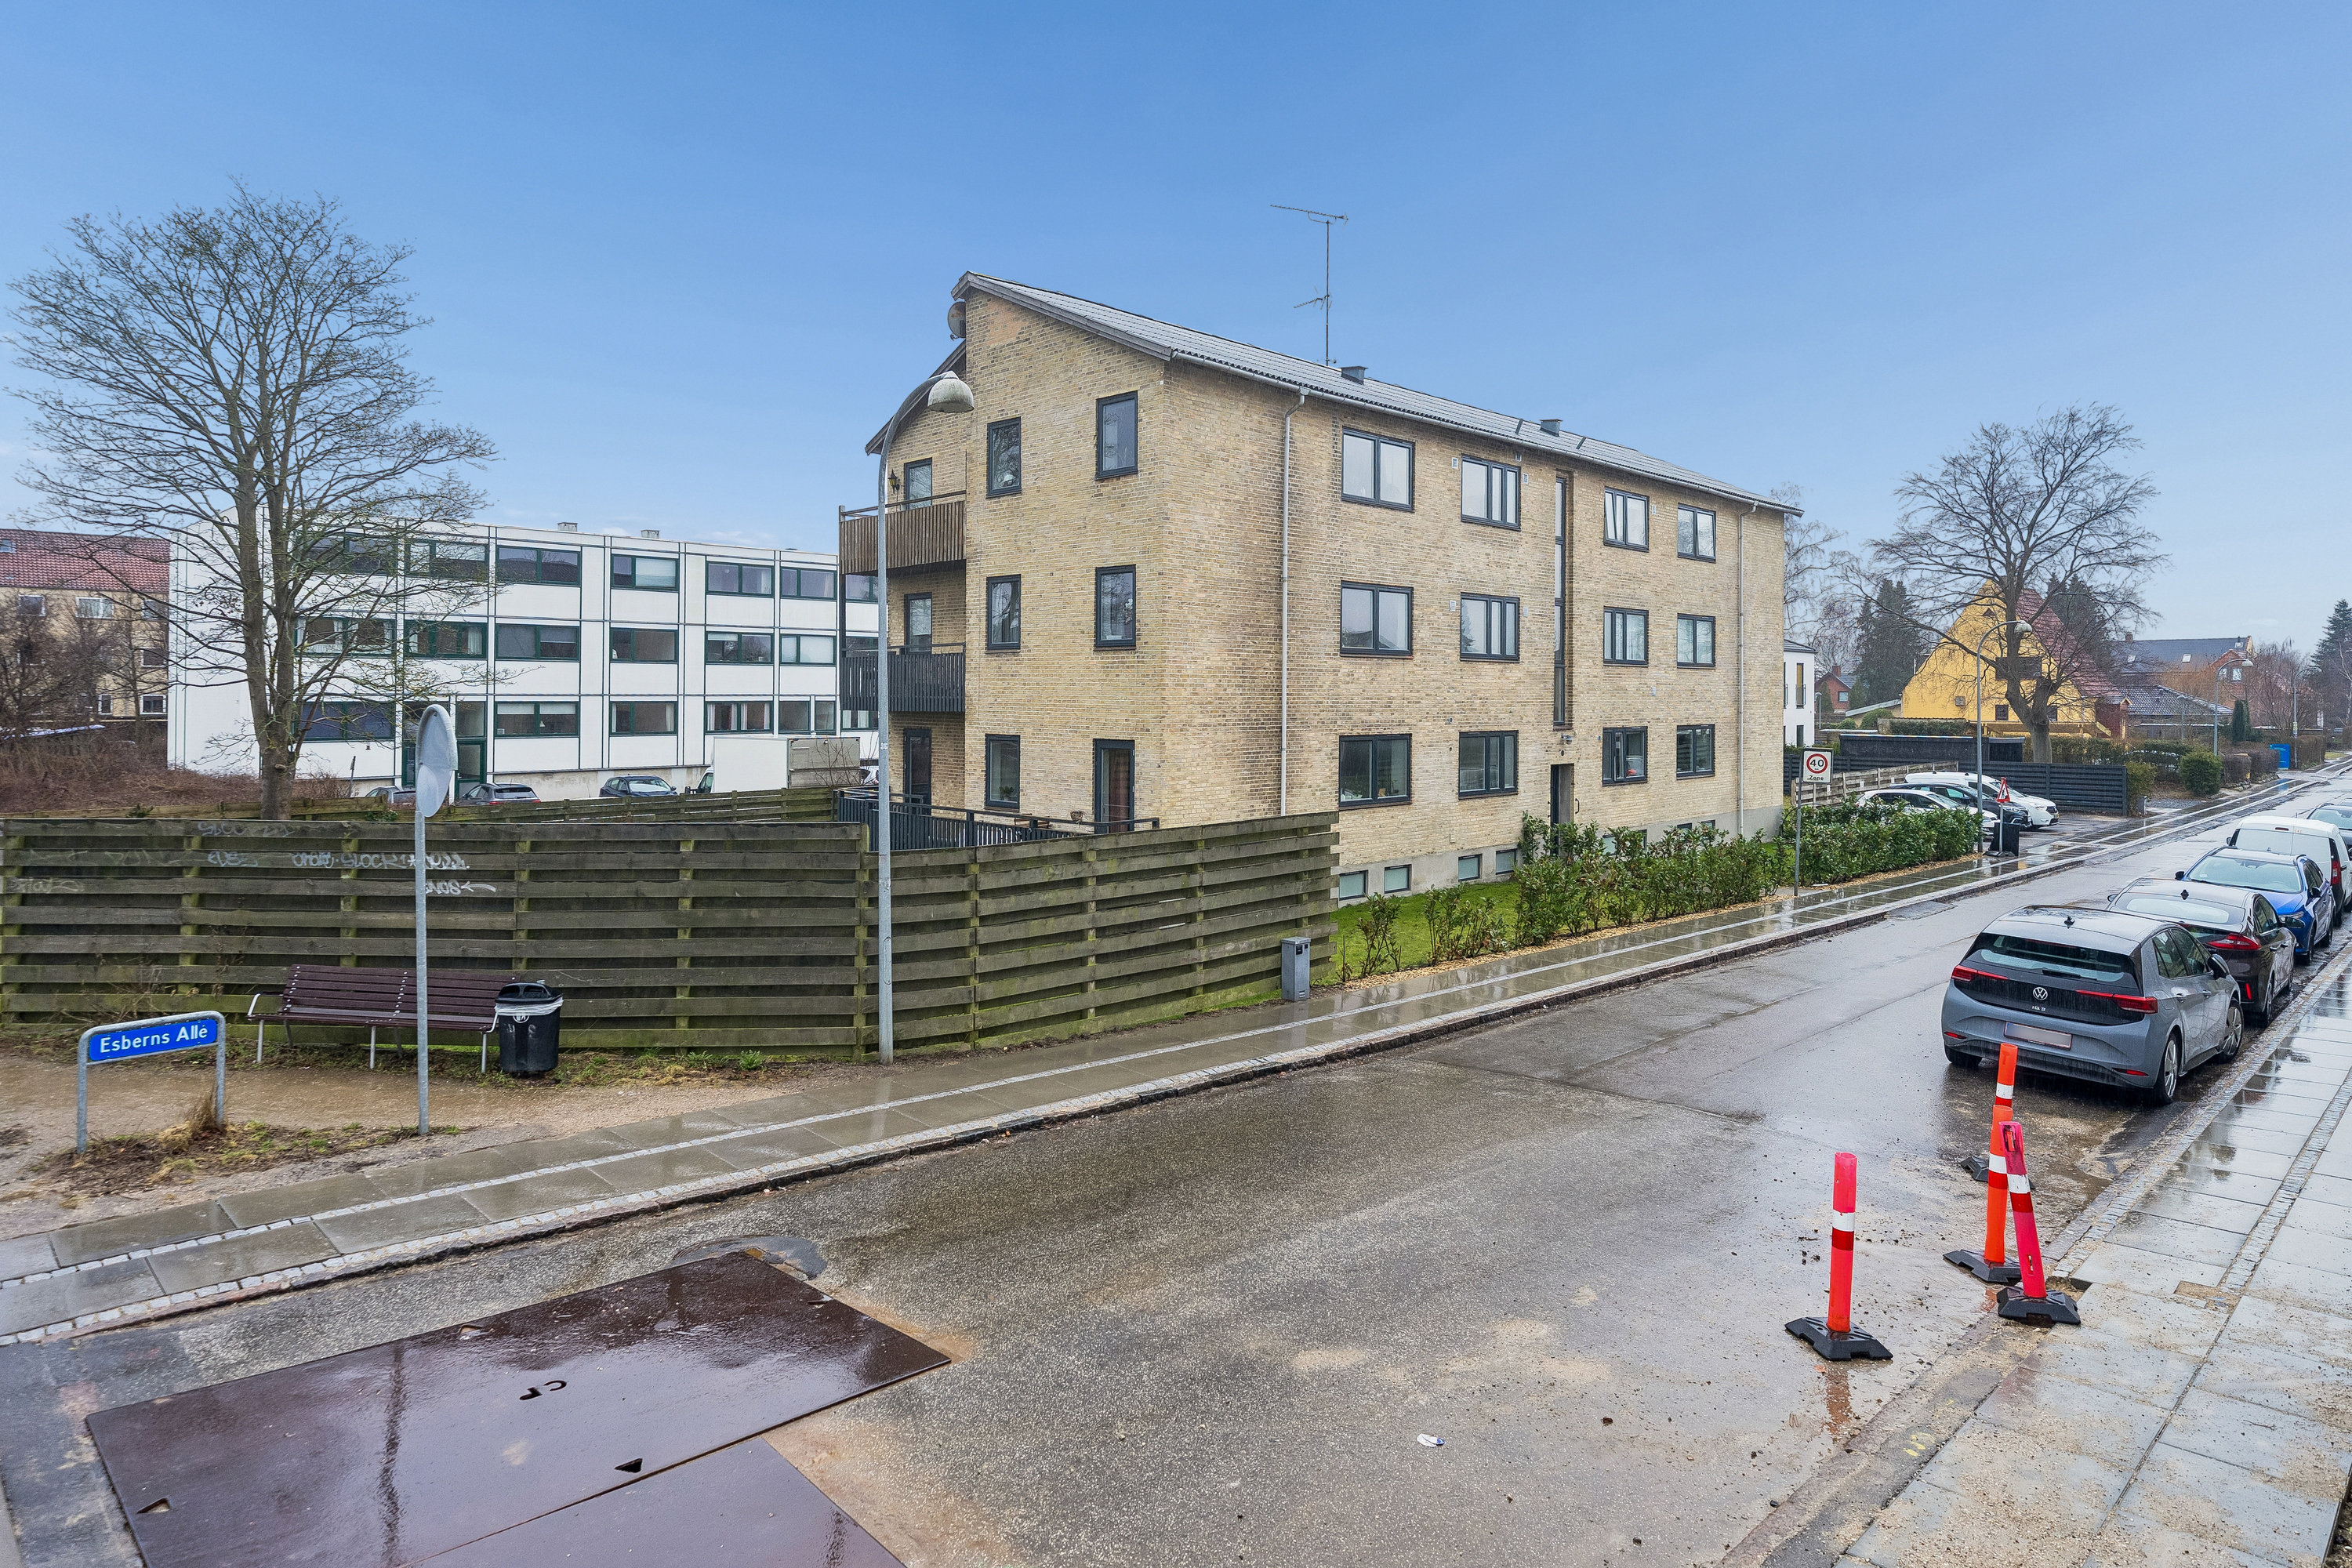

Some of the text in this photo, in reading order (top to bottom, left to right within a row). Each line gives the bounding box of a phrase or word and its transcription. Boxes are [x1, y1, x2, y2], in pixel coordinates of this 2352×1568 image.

[1810, 759, 1824, 768] 40
[100, 1025, 209, 1053] Esberns Allé
